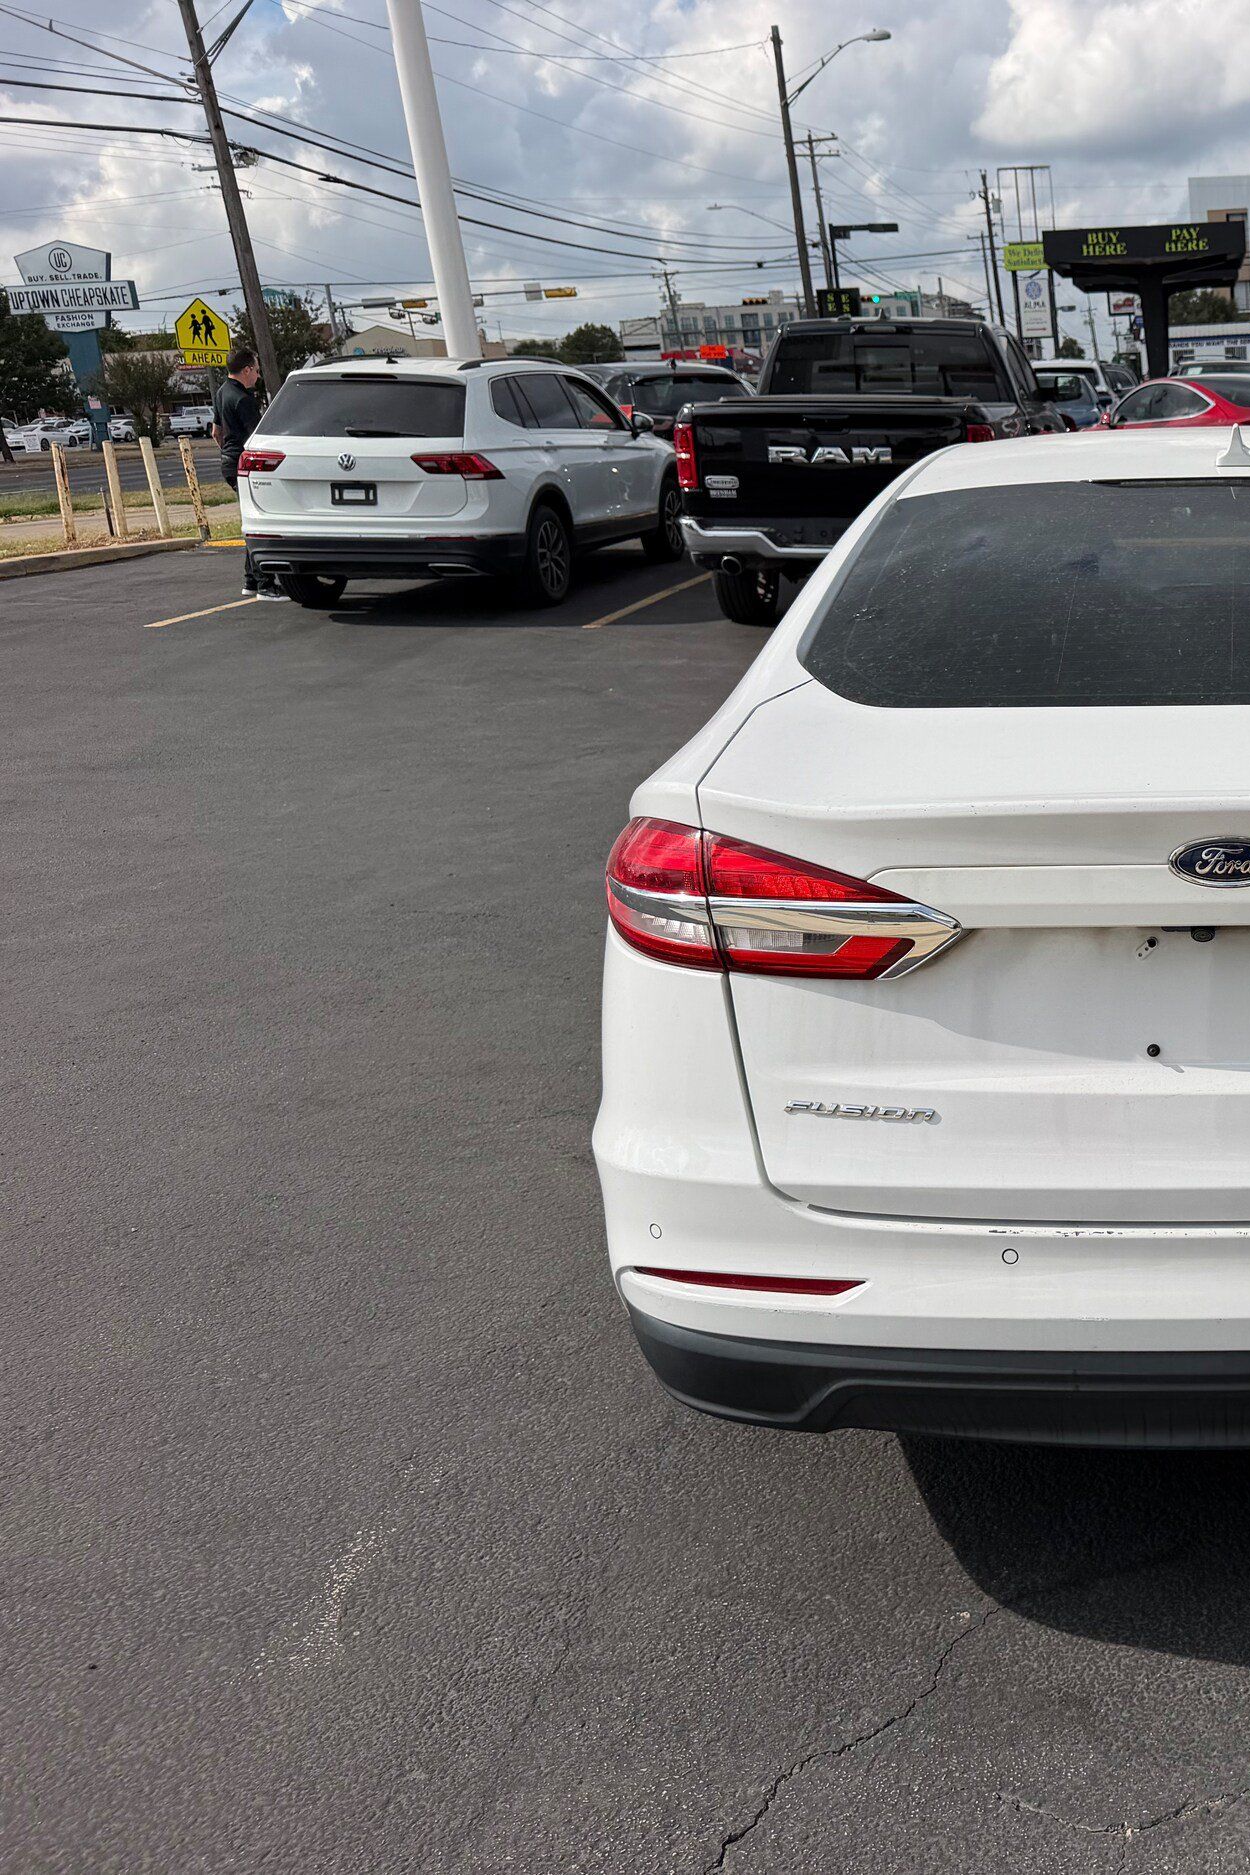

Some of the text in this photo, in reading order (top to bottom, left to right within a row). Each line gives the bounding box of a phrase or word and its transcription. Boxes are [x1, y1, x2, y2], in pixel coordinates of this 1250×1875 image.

[1087, 231, 1120, 244] BUY
[1170, 227, 1200, 240] PAY
[1082, 242, 1128, 256] HERE
[1165, 238, 1209, 253] HERE
[9, 286, 129, 310] UPTOWN CHEAPSKATE
[55, 313, 94, 322] FASHION
[57, 321, 95, 329] EXCHANGE
[192, 352, 223, 364] AHEAD
[768, 446, 892, 464] RAM
[784, 1099, 935, 1121] FUSION
